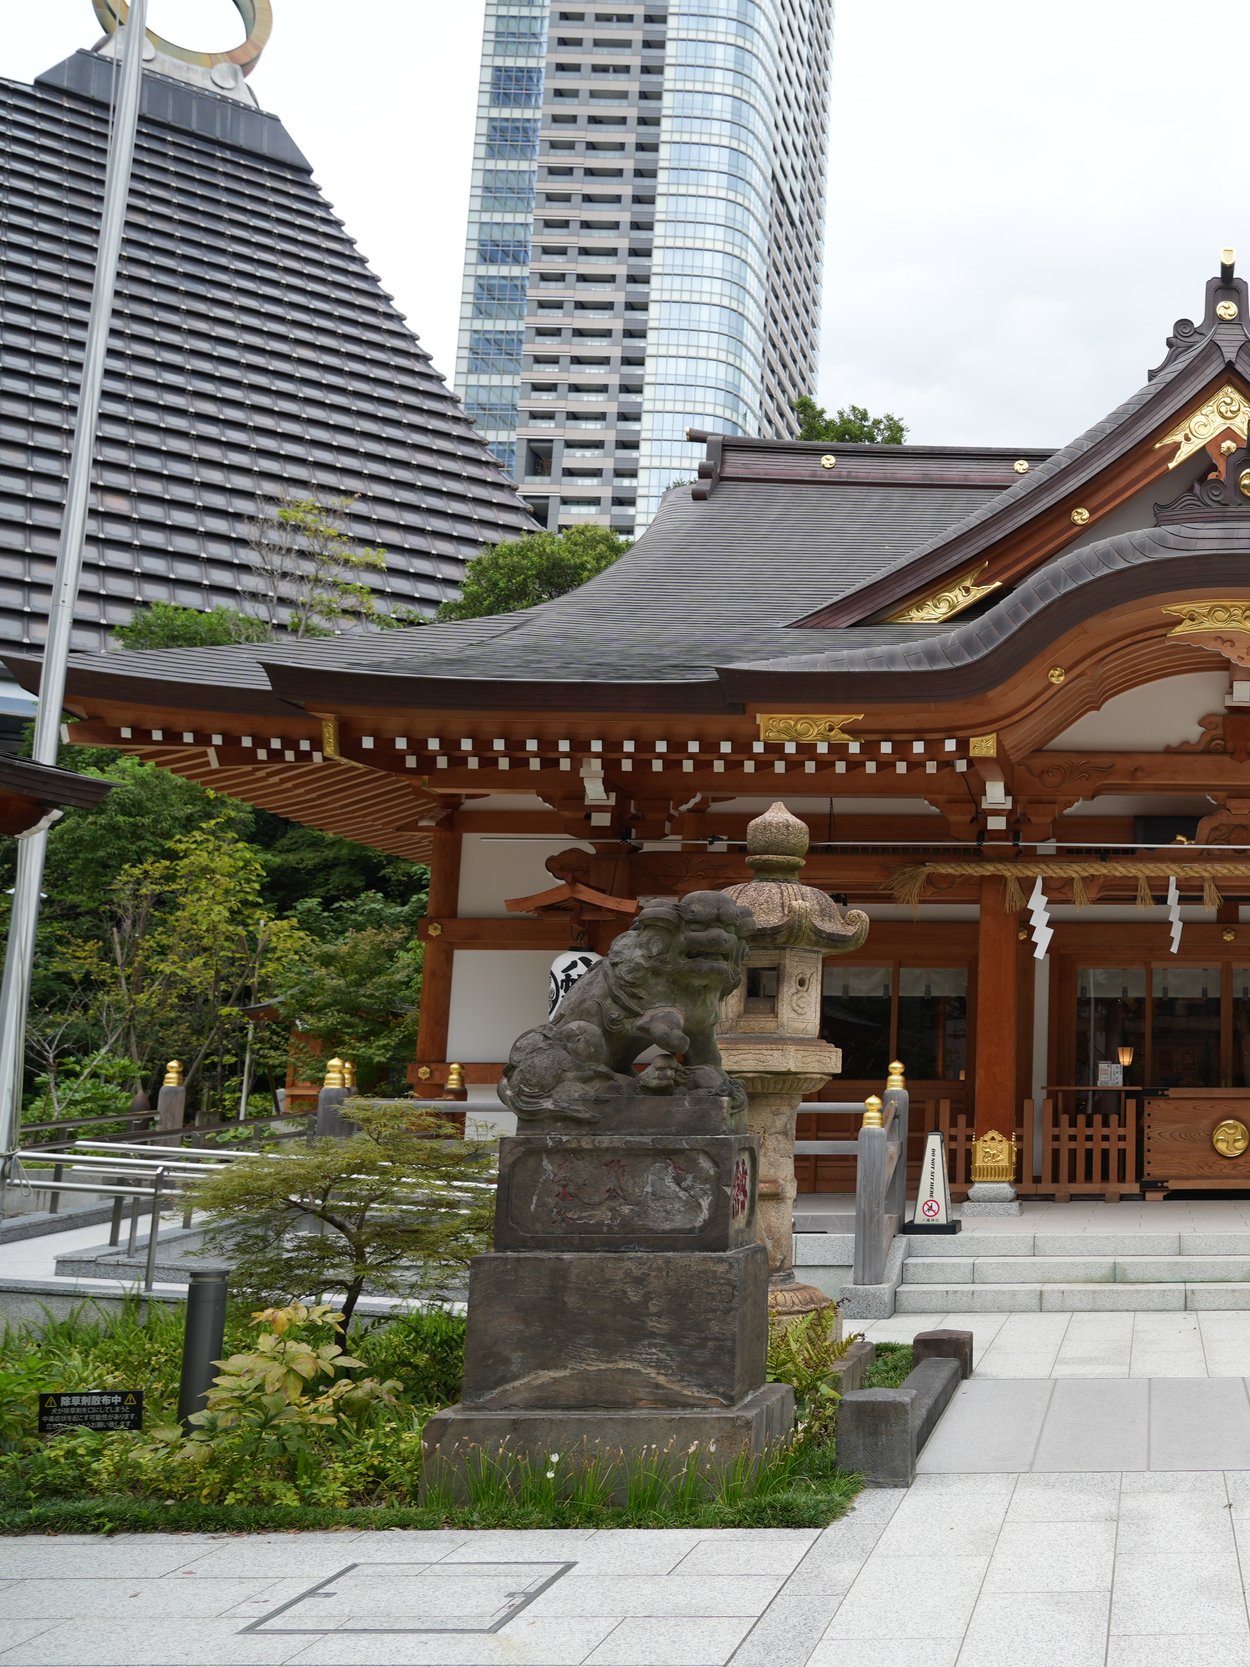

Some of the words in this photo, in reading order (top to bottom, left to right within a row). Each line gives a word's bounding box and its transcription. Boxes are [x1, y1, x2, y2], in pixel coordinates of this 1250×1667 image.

[931, 1148, 936, 1157] DO
[61, 1395, 122, 1406] 除草剤散布中
